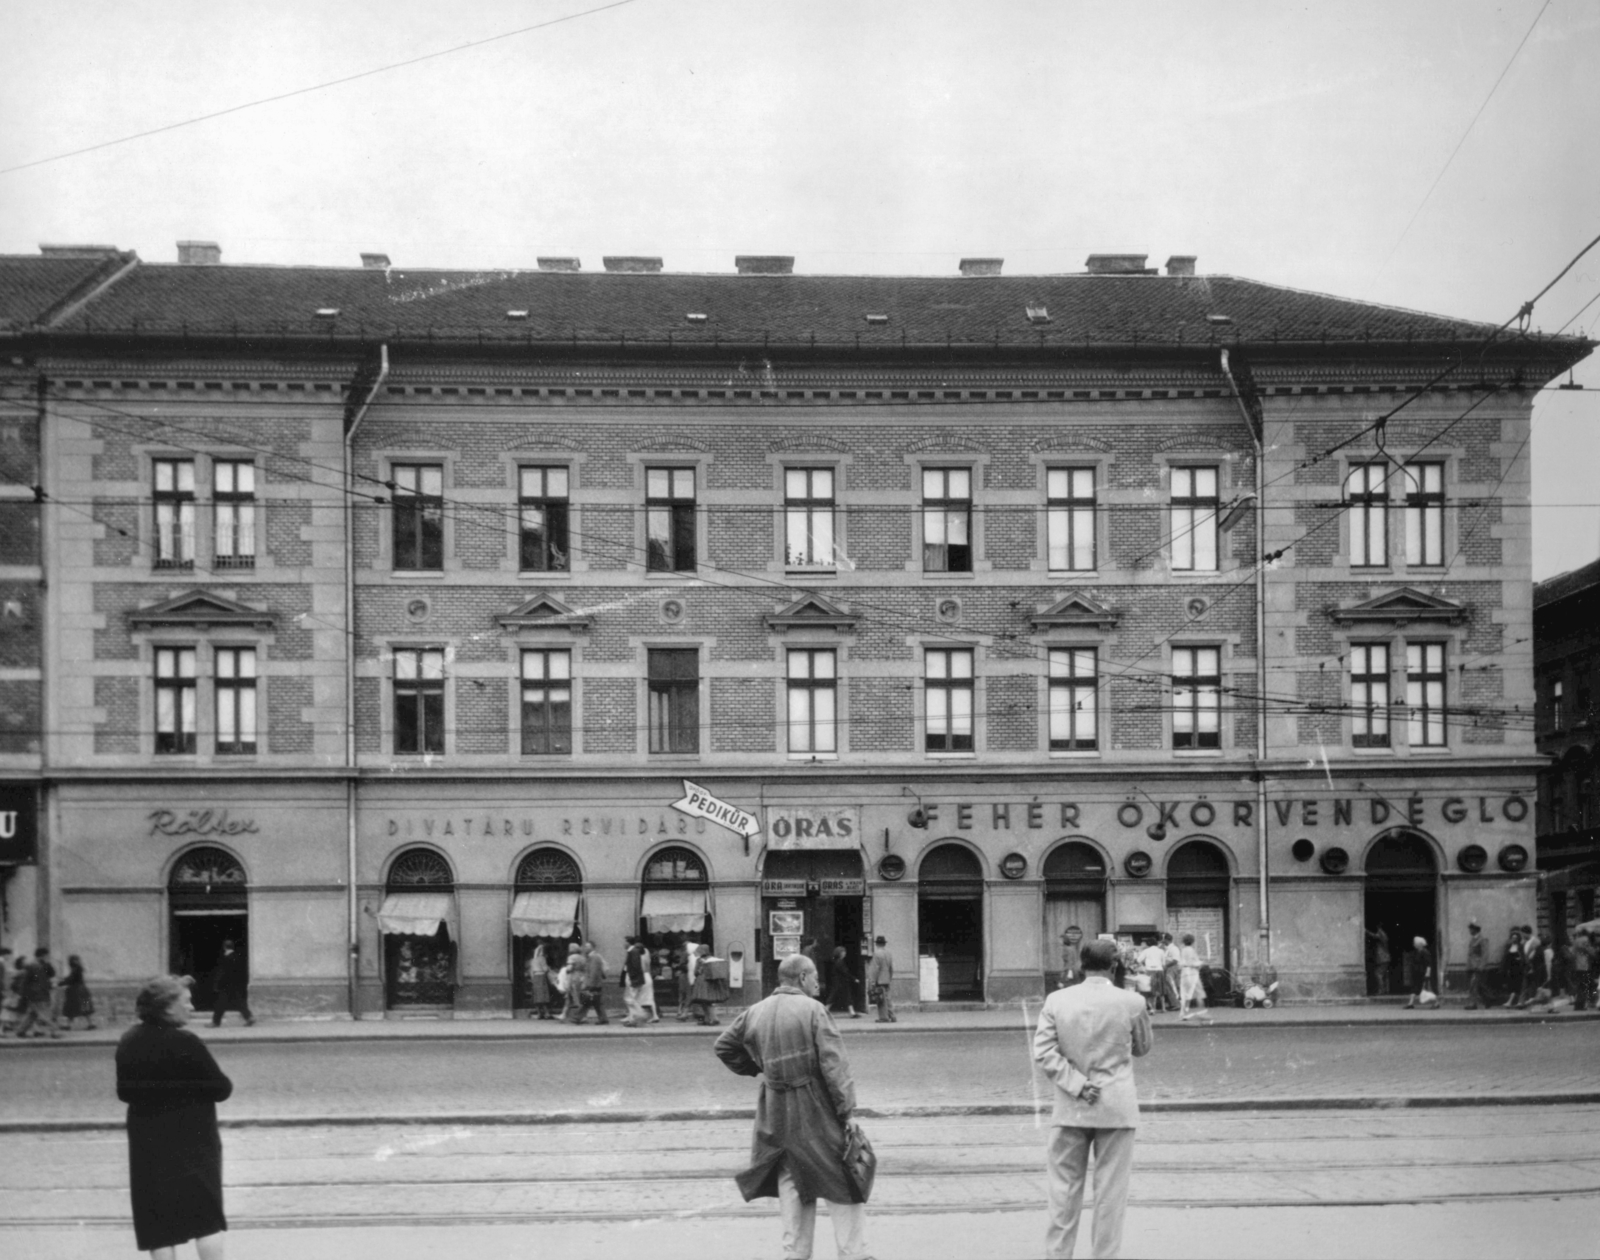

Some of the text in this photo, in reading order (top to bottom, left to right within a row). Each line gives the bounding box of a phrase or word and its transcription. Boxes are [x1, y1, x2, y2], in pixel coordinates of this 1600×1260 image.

[688, 793, 749, 831] PEDIKÜR
[923, 795, 1081, 830] FEHÉR
[1117, 794, 1253, 828] ÖKÖR
